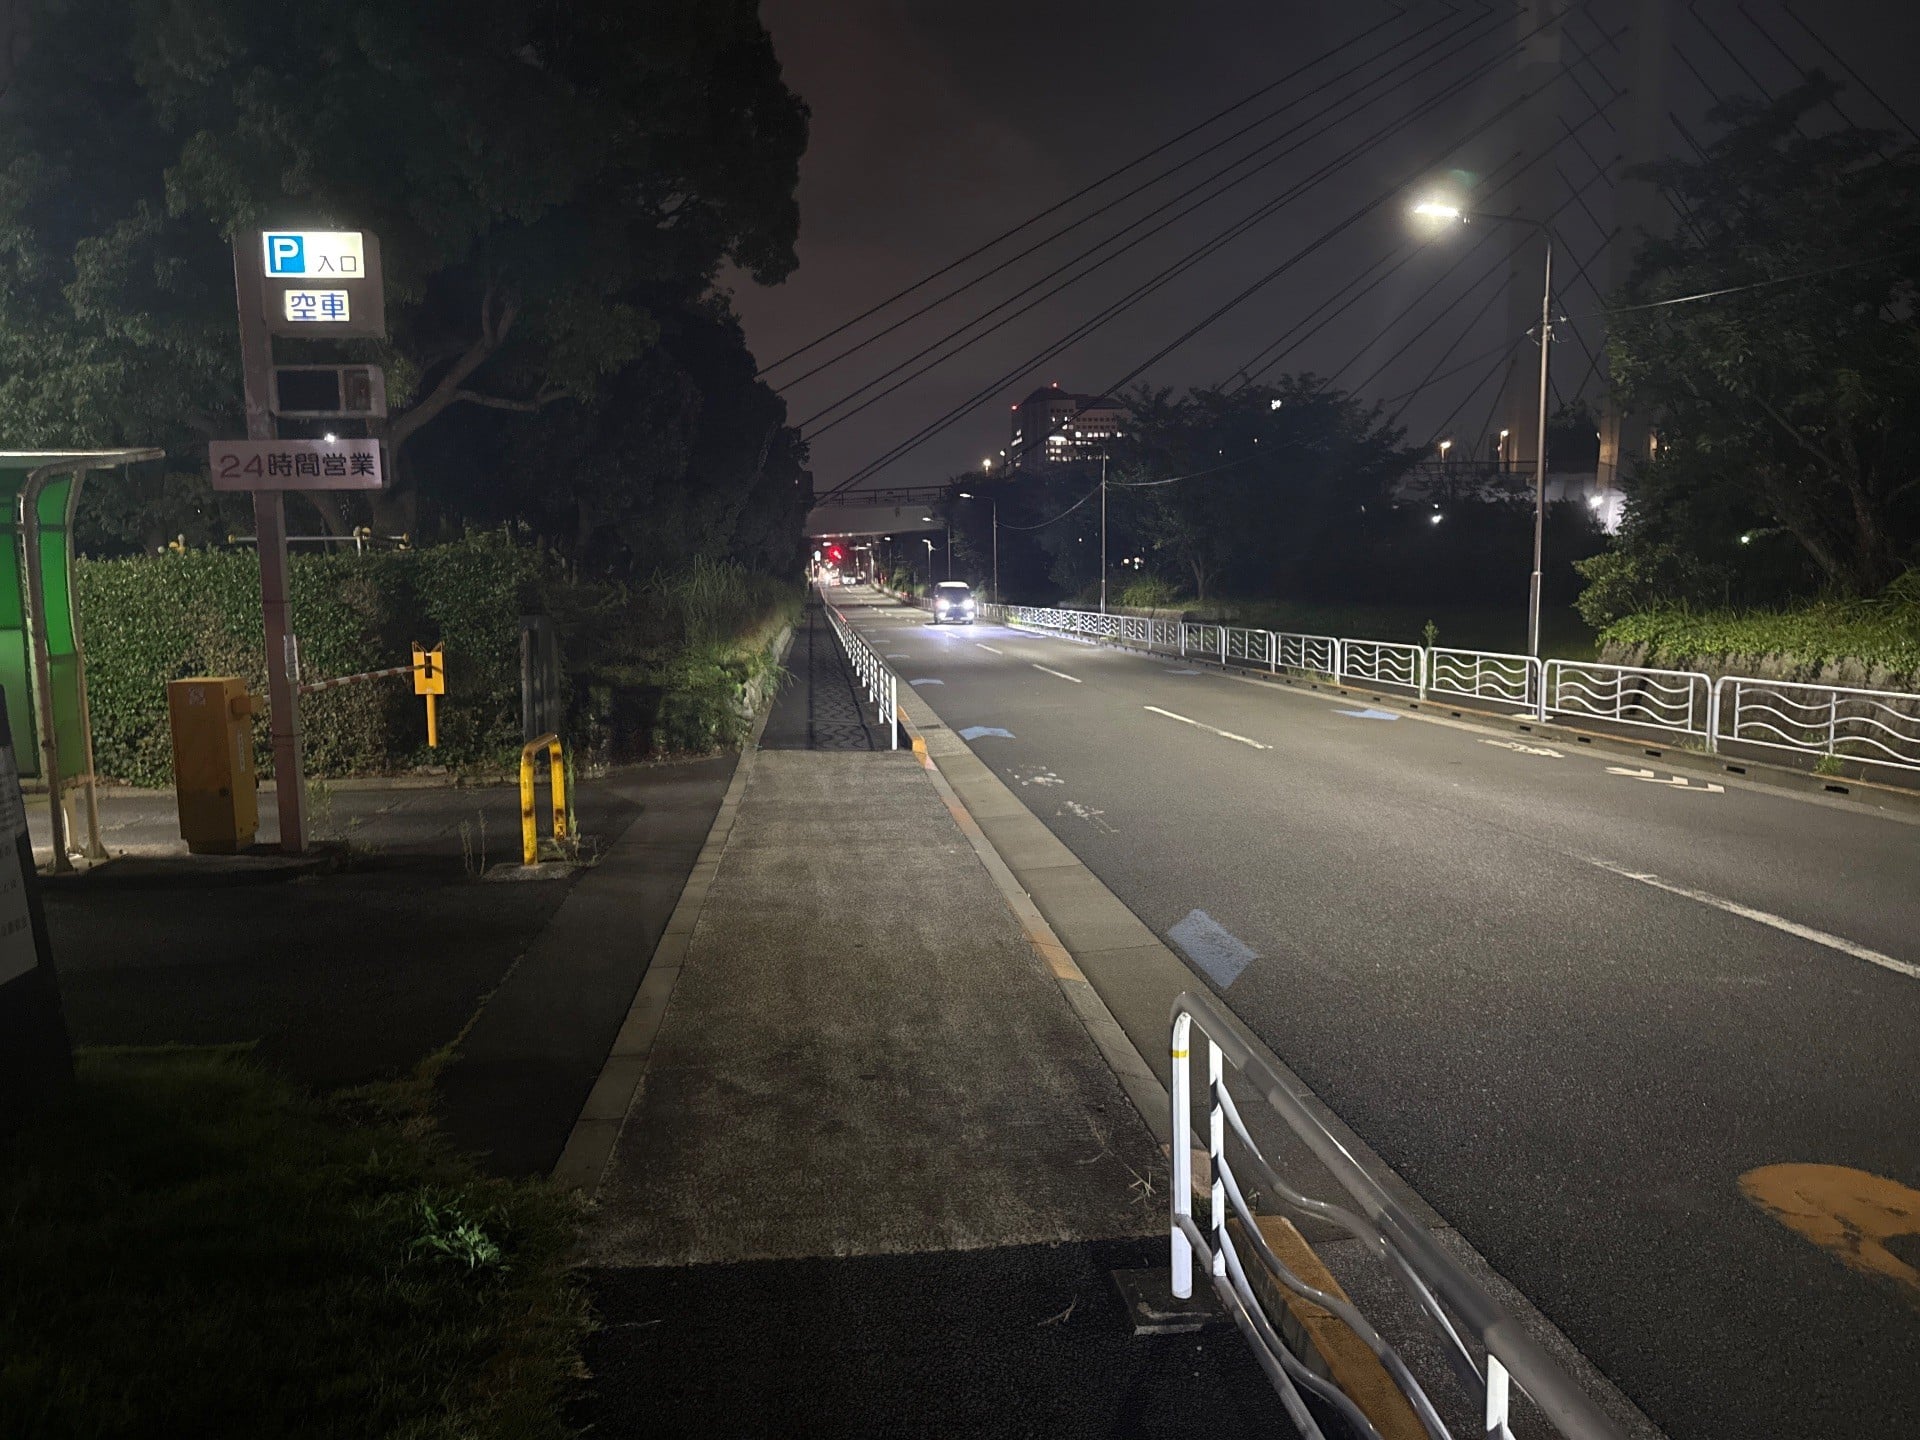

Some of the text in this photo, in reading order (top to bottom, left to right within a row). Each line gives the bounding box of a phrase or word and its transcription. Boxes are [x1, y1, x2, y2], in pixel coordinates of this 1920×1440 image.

[273, 238, 357, 273] P 入口
[290, 292, 346, 320] 空車
[219, 453, 376, 479] 24時間営業
